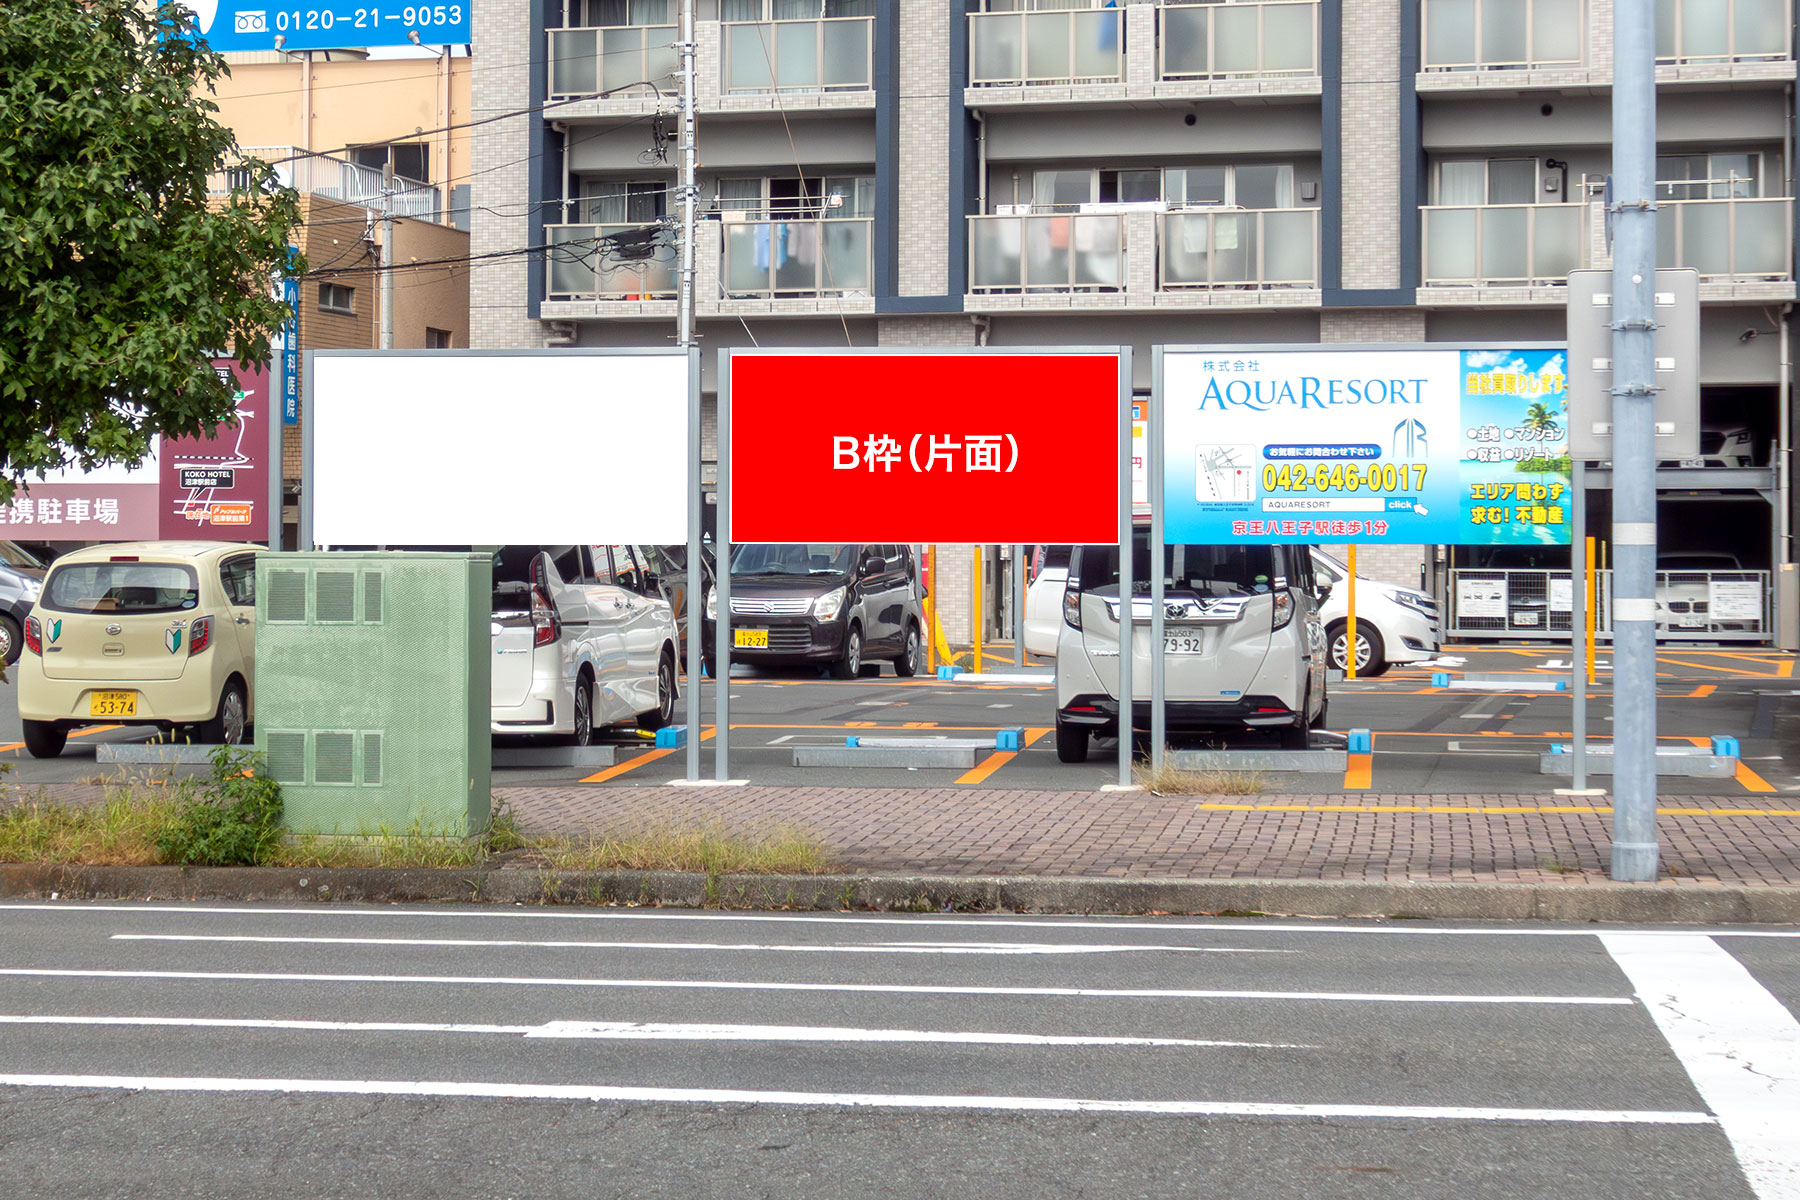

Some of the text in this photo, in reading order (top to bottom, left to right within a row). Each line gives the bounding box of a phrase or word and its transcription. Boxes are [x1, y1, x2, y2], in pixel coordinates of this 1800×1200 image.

[276, 5, 462, 31] 0120-21-9053
[287, 287, 298, 418] 小歯科医院
[1202, 360, 1260, 372] 株式会社
[1466, 373, 1565, 394] 当社買取りします
[1477, 426, 1565, 442] 土地 マンション
[1477, 447, 1553, 463] 収益 リゾート
[1262, 463, 1427, 492] 042-646-0017
[1470, 482, 1564, 500] エリア問わず
[0, 498, 119, 524] 携駐車場
[1388, 500, 1412, 509] click
[1232, 520, 1388, 535] 京王八王子駅徒歩1分
[742, 637, 767, 646] 12-27
[1163, 638, 1200, 651] 79-92
[100, 701, 134, 713] 53-74
